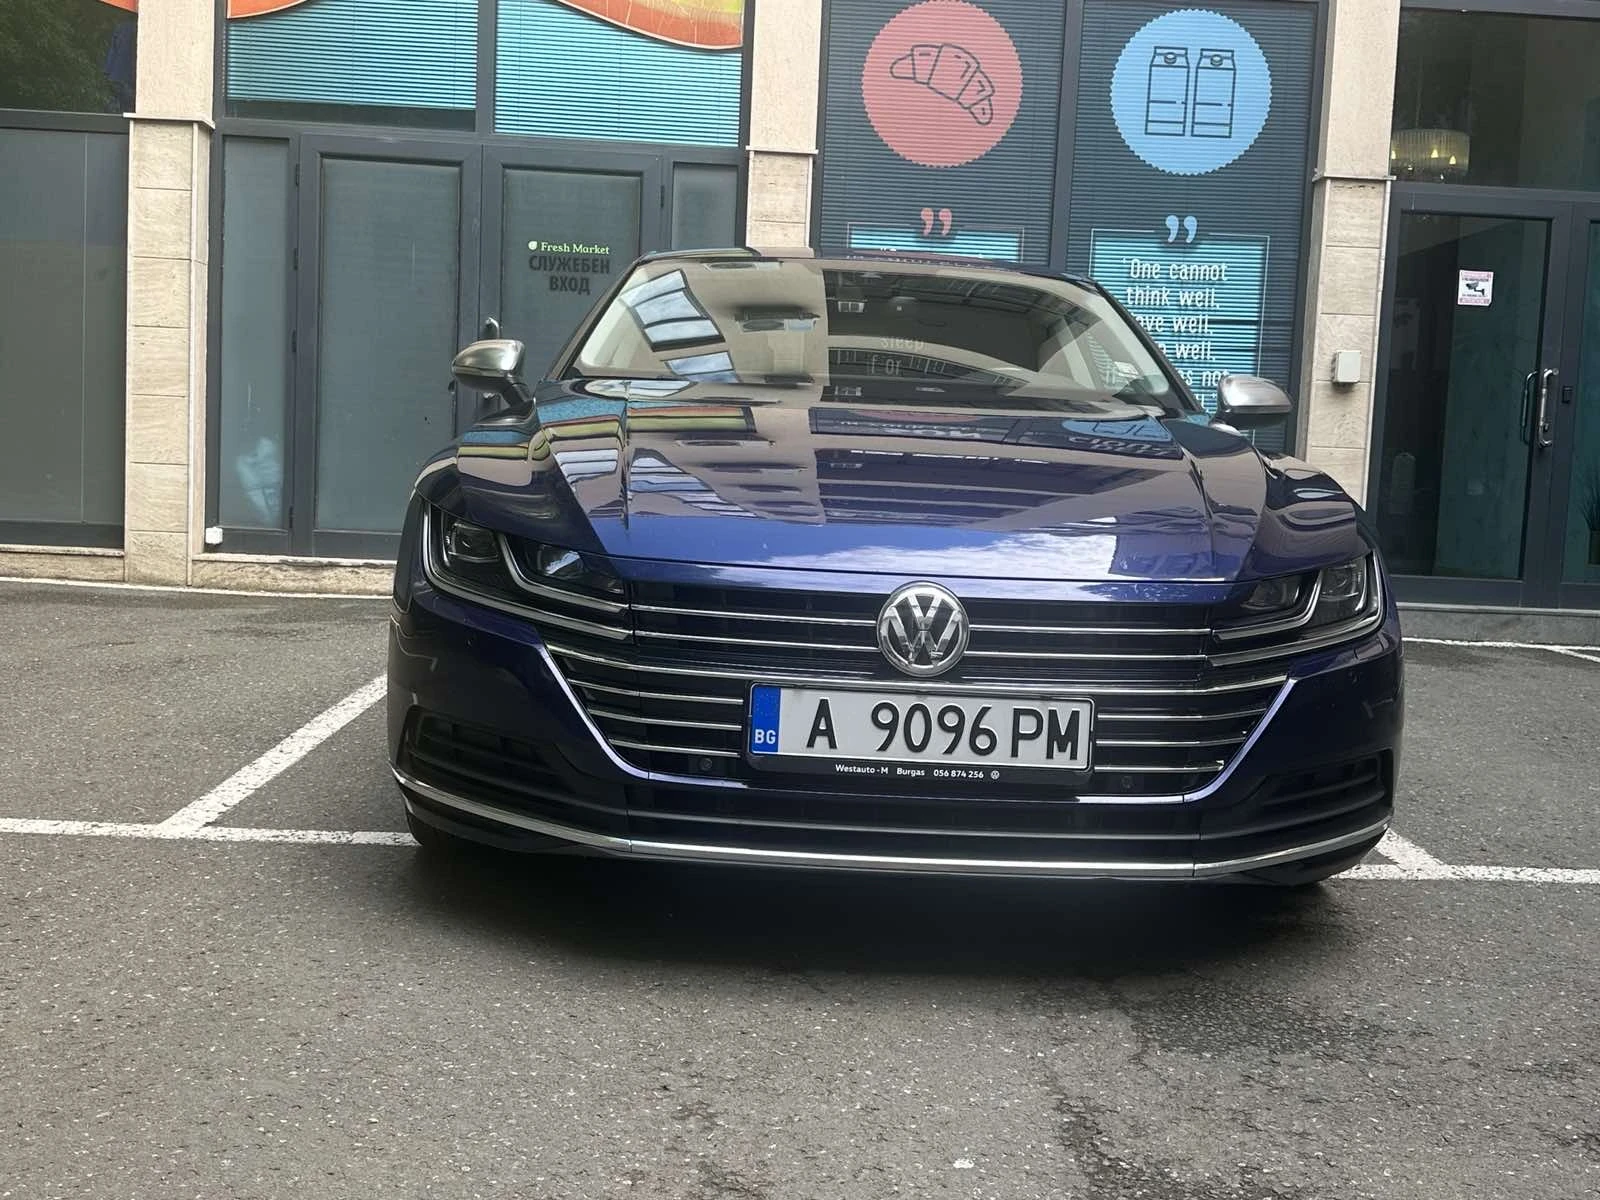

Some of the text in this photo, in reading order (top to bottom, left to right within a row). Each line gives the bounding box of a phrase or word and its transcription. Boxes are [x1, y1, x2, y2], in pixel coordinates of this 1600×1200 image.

[541, 241, 609, 255] Fresh Market
[528, 255, 610, 274] СЛУЖЕБЕН
[1169, 262, 1229, 281] cannot
[549, 275, 591, 296] ВХОД
[1126, 286, 1170, 307] think
[753, 728, 777, 744] BG
[806, 697, 1081, 761] A 9096 PM
[896, 767, 926, 778] Burgas
[933, 769, 949, 777] 056
[951, 769, 967, 778] 874
[968, 770, 984, 779] 256
